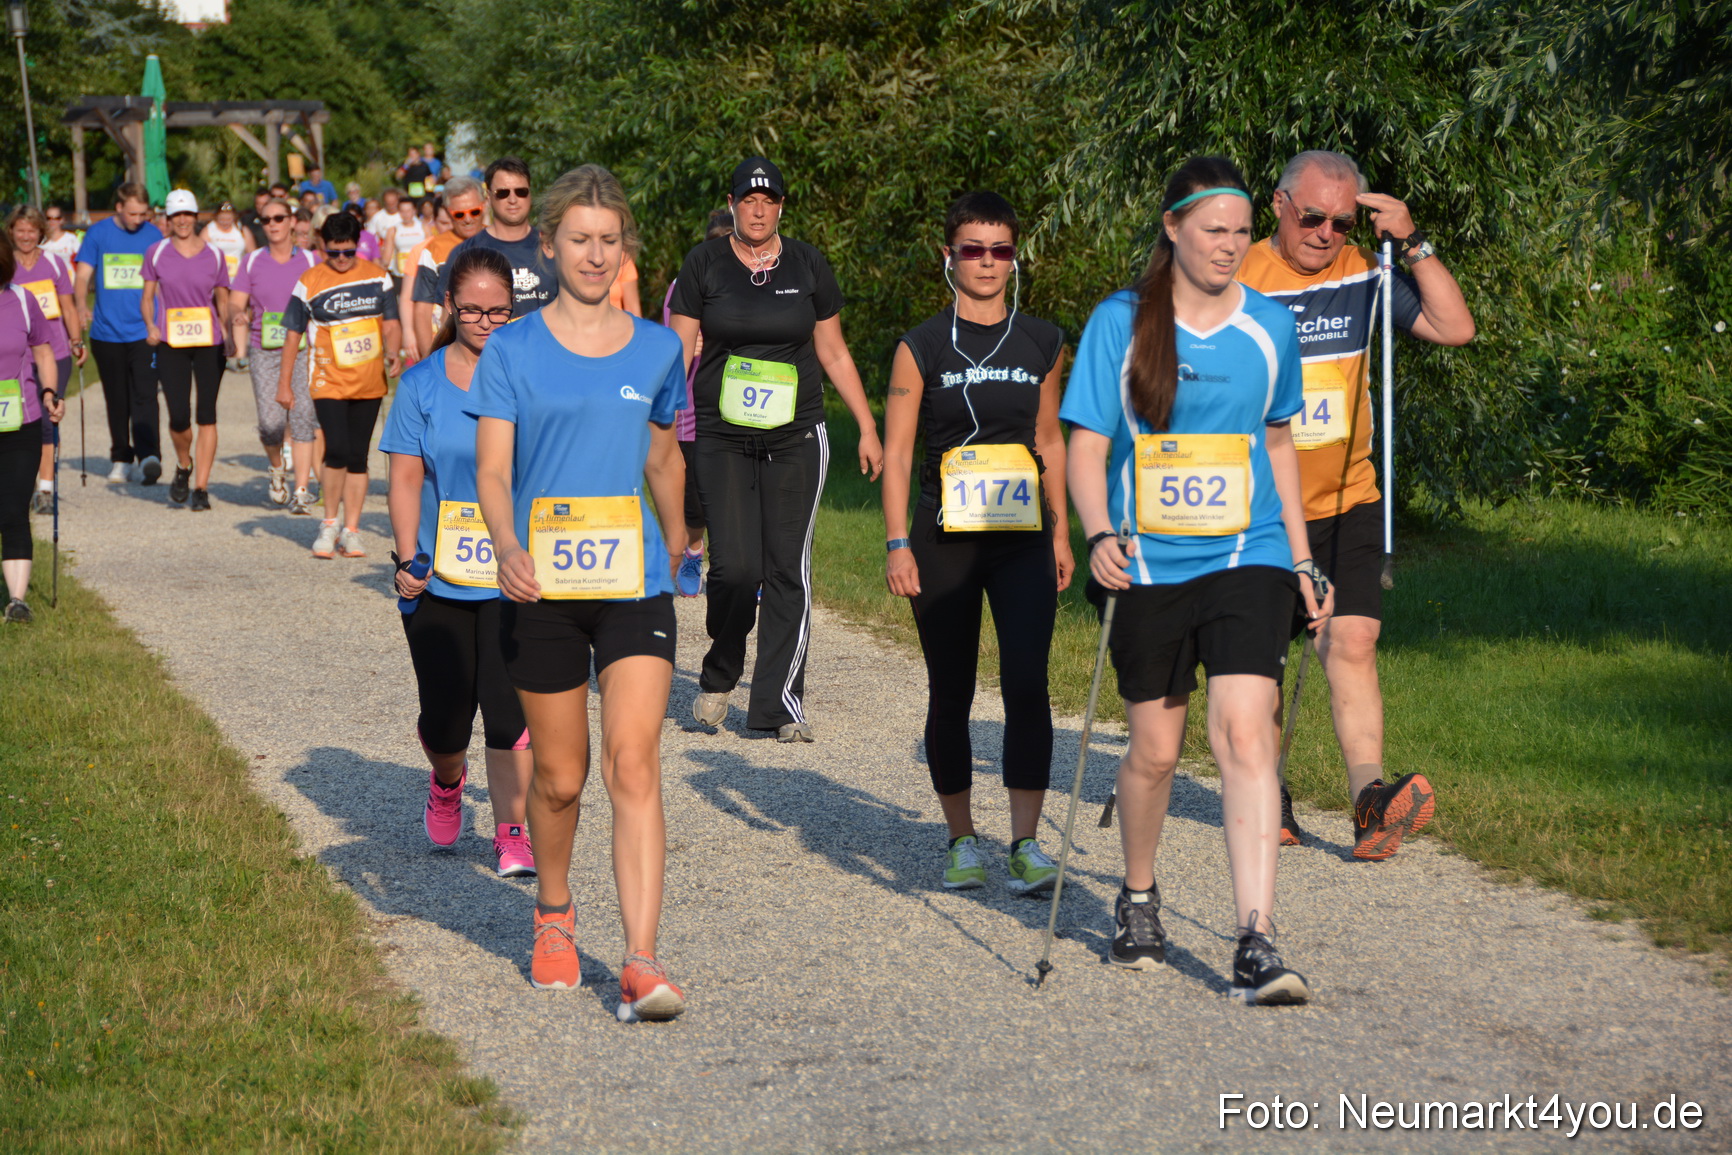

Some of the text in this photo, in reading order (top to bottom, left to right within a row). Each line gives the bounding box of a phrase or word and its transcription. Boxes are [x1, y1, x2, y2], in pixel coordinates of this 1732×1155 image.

[112, 267, 136, 279] 737
[40, 296, 49, 309] 2
[333, 294, 378, 310] Fischer
[515, 291, 537, 302] guad
[339, 303, 376, 314] AUTOMOBILE
[176, 323, 203, 336] 320
[344, 338, 372, 355] 438
[742, 386, 774, 410] 97
[953, 479, 1031, 506] 1174
[1159, 475, 1227, 507] 562
[545, 514, 586, 522] firmenlauf
[535, 525, 566, 533] walken
[552, 538, 620, 571] 567
[465, 568, 485, 576] Marina
[555, 577, 618, 585] Sabrina Kundinger
